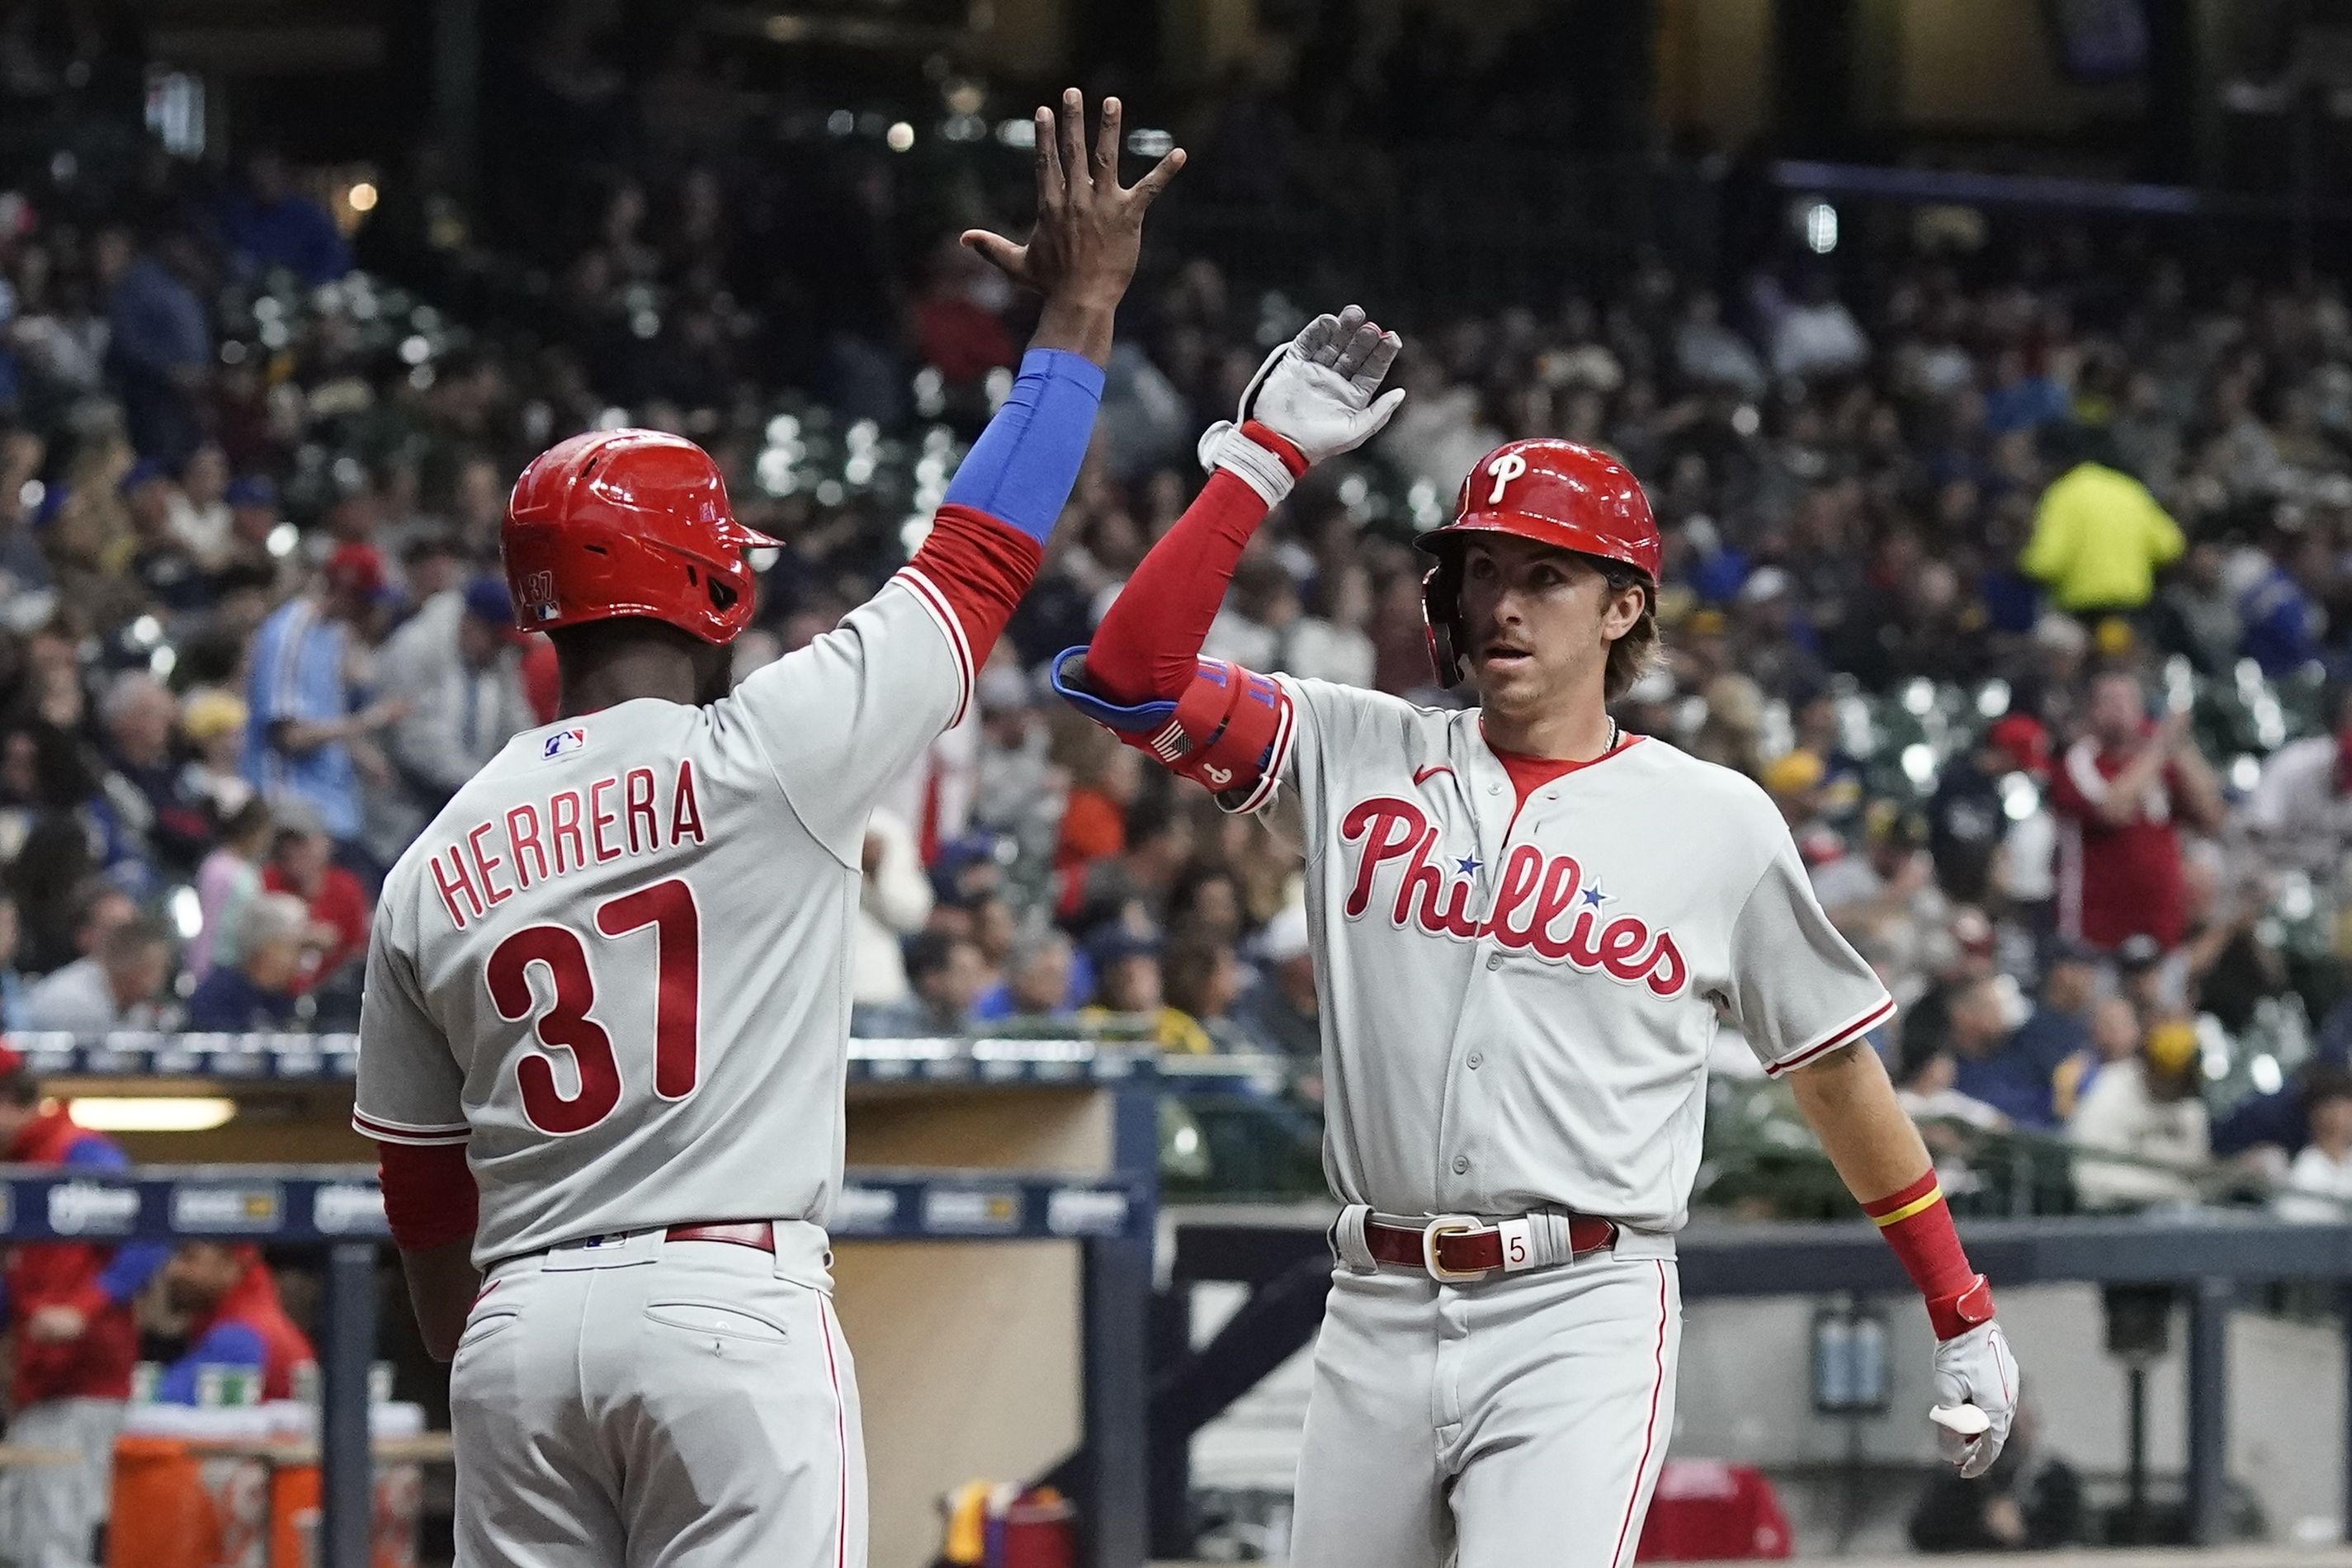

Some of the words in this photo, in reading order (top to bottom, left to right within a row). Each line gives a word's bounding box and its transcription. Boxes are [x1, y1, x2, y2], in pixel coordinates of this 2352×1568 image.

[1487, 454, 1526, 505] P
[528, 570, 552, 601] 37
[1203, 763, 1232, 784] P
[428, 758, 706, 931] HERRERA
[1341, 796, 1692, 1000] Phillies
[484, 876, 701, 1137] 37
[1510, 1236, 1525, 1263] 5
